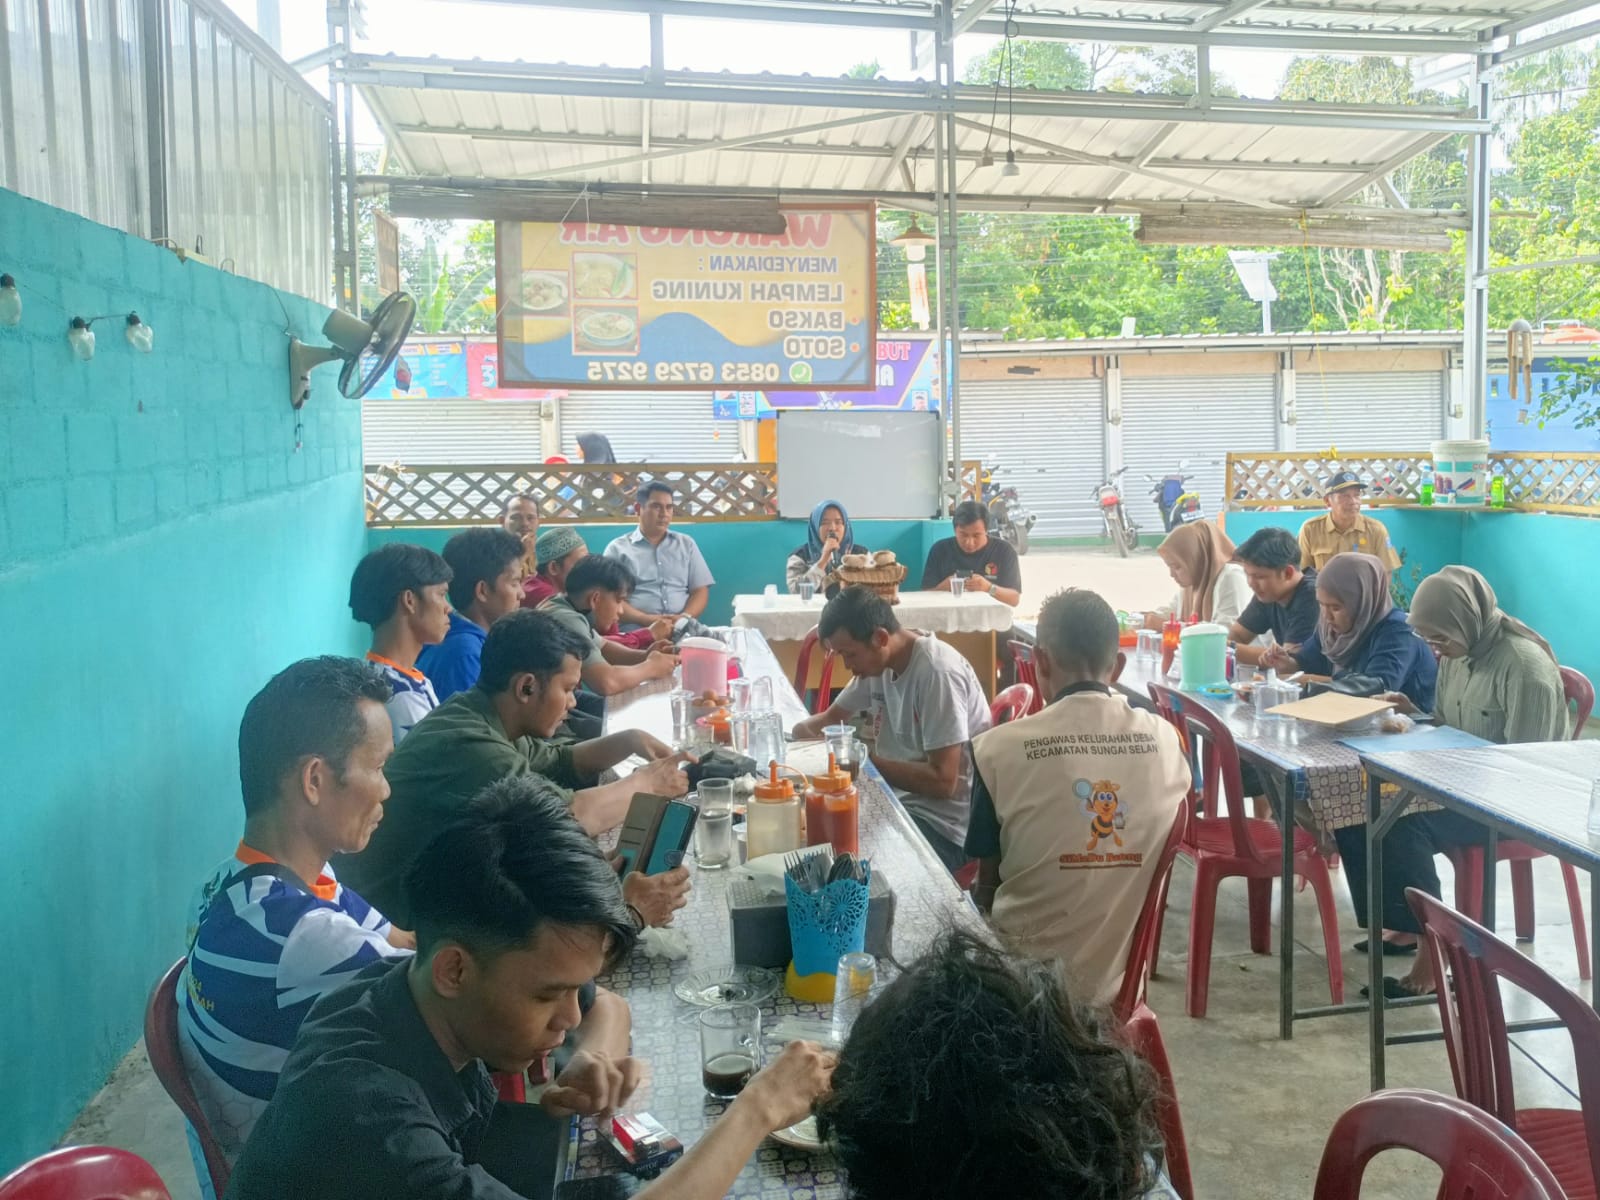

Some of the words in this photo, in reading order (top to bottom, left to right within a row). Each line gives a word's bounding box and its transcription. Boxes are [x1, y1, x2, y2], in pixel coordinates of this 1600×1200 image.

[1024, 735, 1076, 750] PENGAWAS
[1078, 734, 1131, 744] KELURAHAN
[1133, 733, 1156, 743] DESA
[1026, 746, 1088, 760] KECAMATAN
[1090, 745, 1127, 756] SUNGAI
[1129, 744, 1159, 754] SELAN
